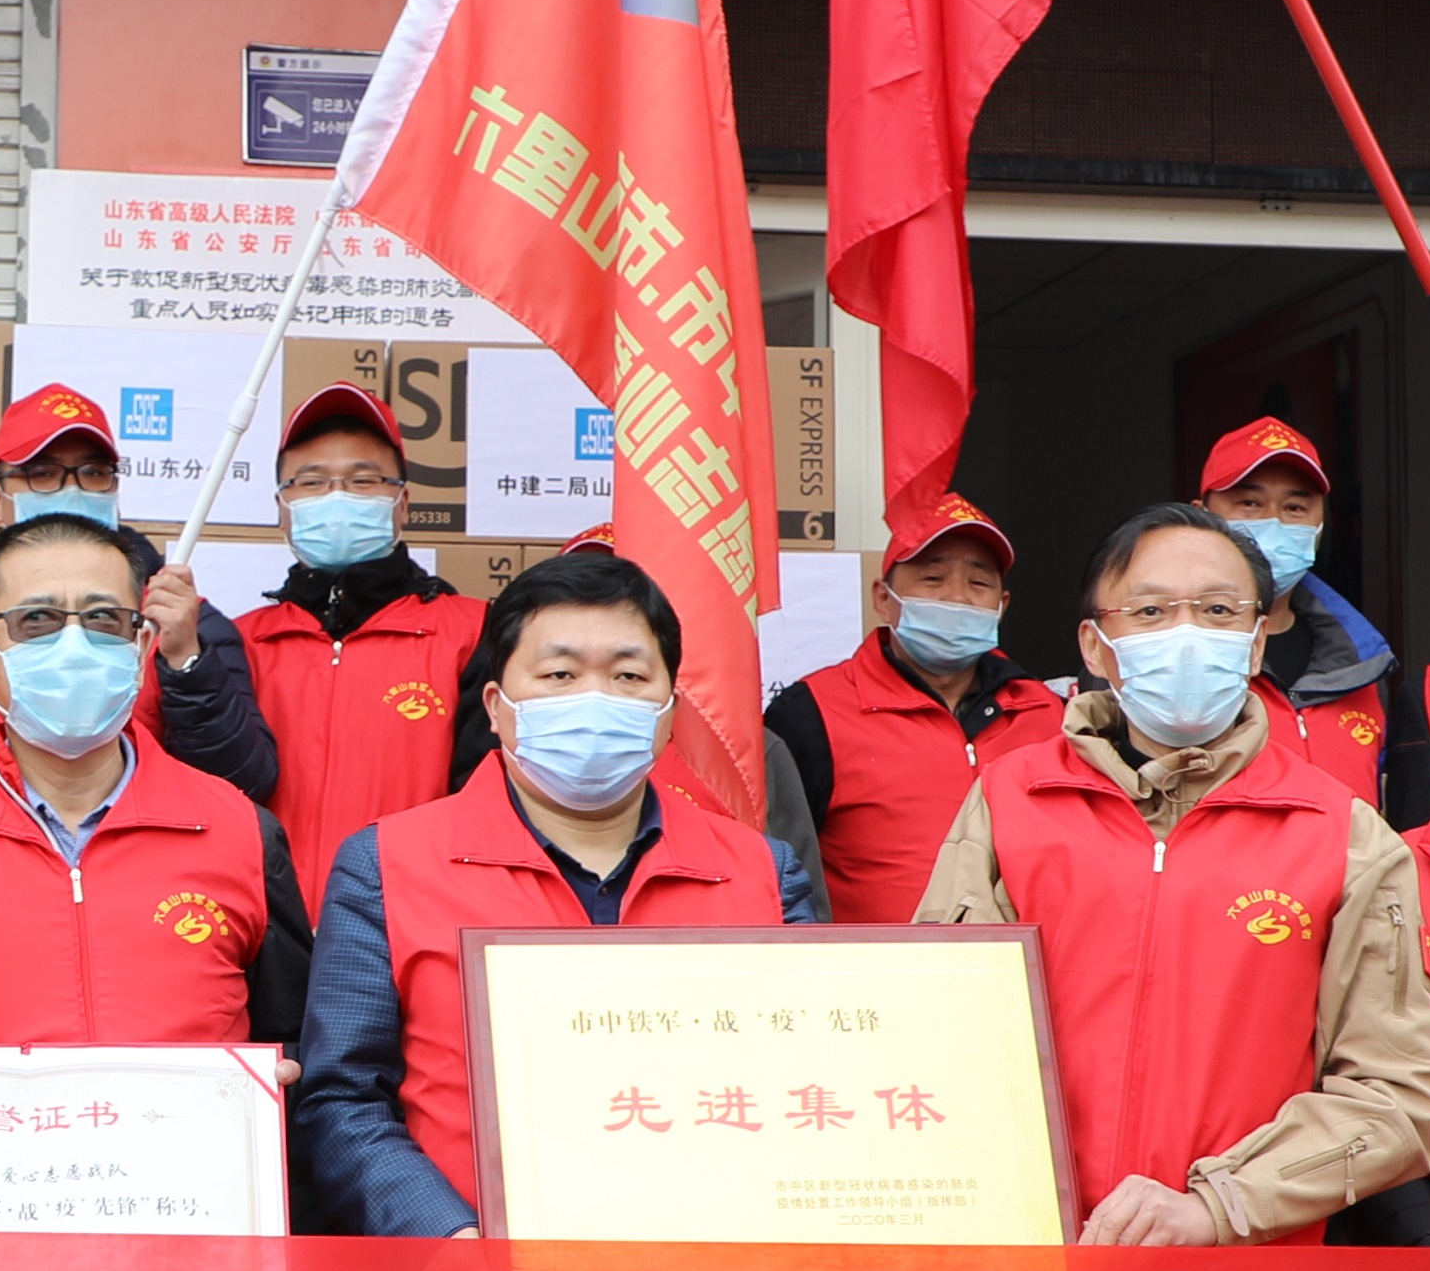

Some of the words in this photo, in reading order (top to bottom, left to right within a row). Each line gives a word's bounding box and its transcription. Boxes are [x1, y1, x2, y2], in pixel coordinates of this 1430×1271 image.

[104, 199, 296, 226] 山东省高级人民法院
[103, 228, 294, 255] 山东省公安厅
[800, 358, 824, 387] SF
[800, 396, 824, 496] EXPRESS
[410, 511, 451, 524] 95338
[803, 512, 824, 540] 6
[603, 1082, 947, 1133] 先进集体
